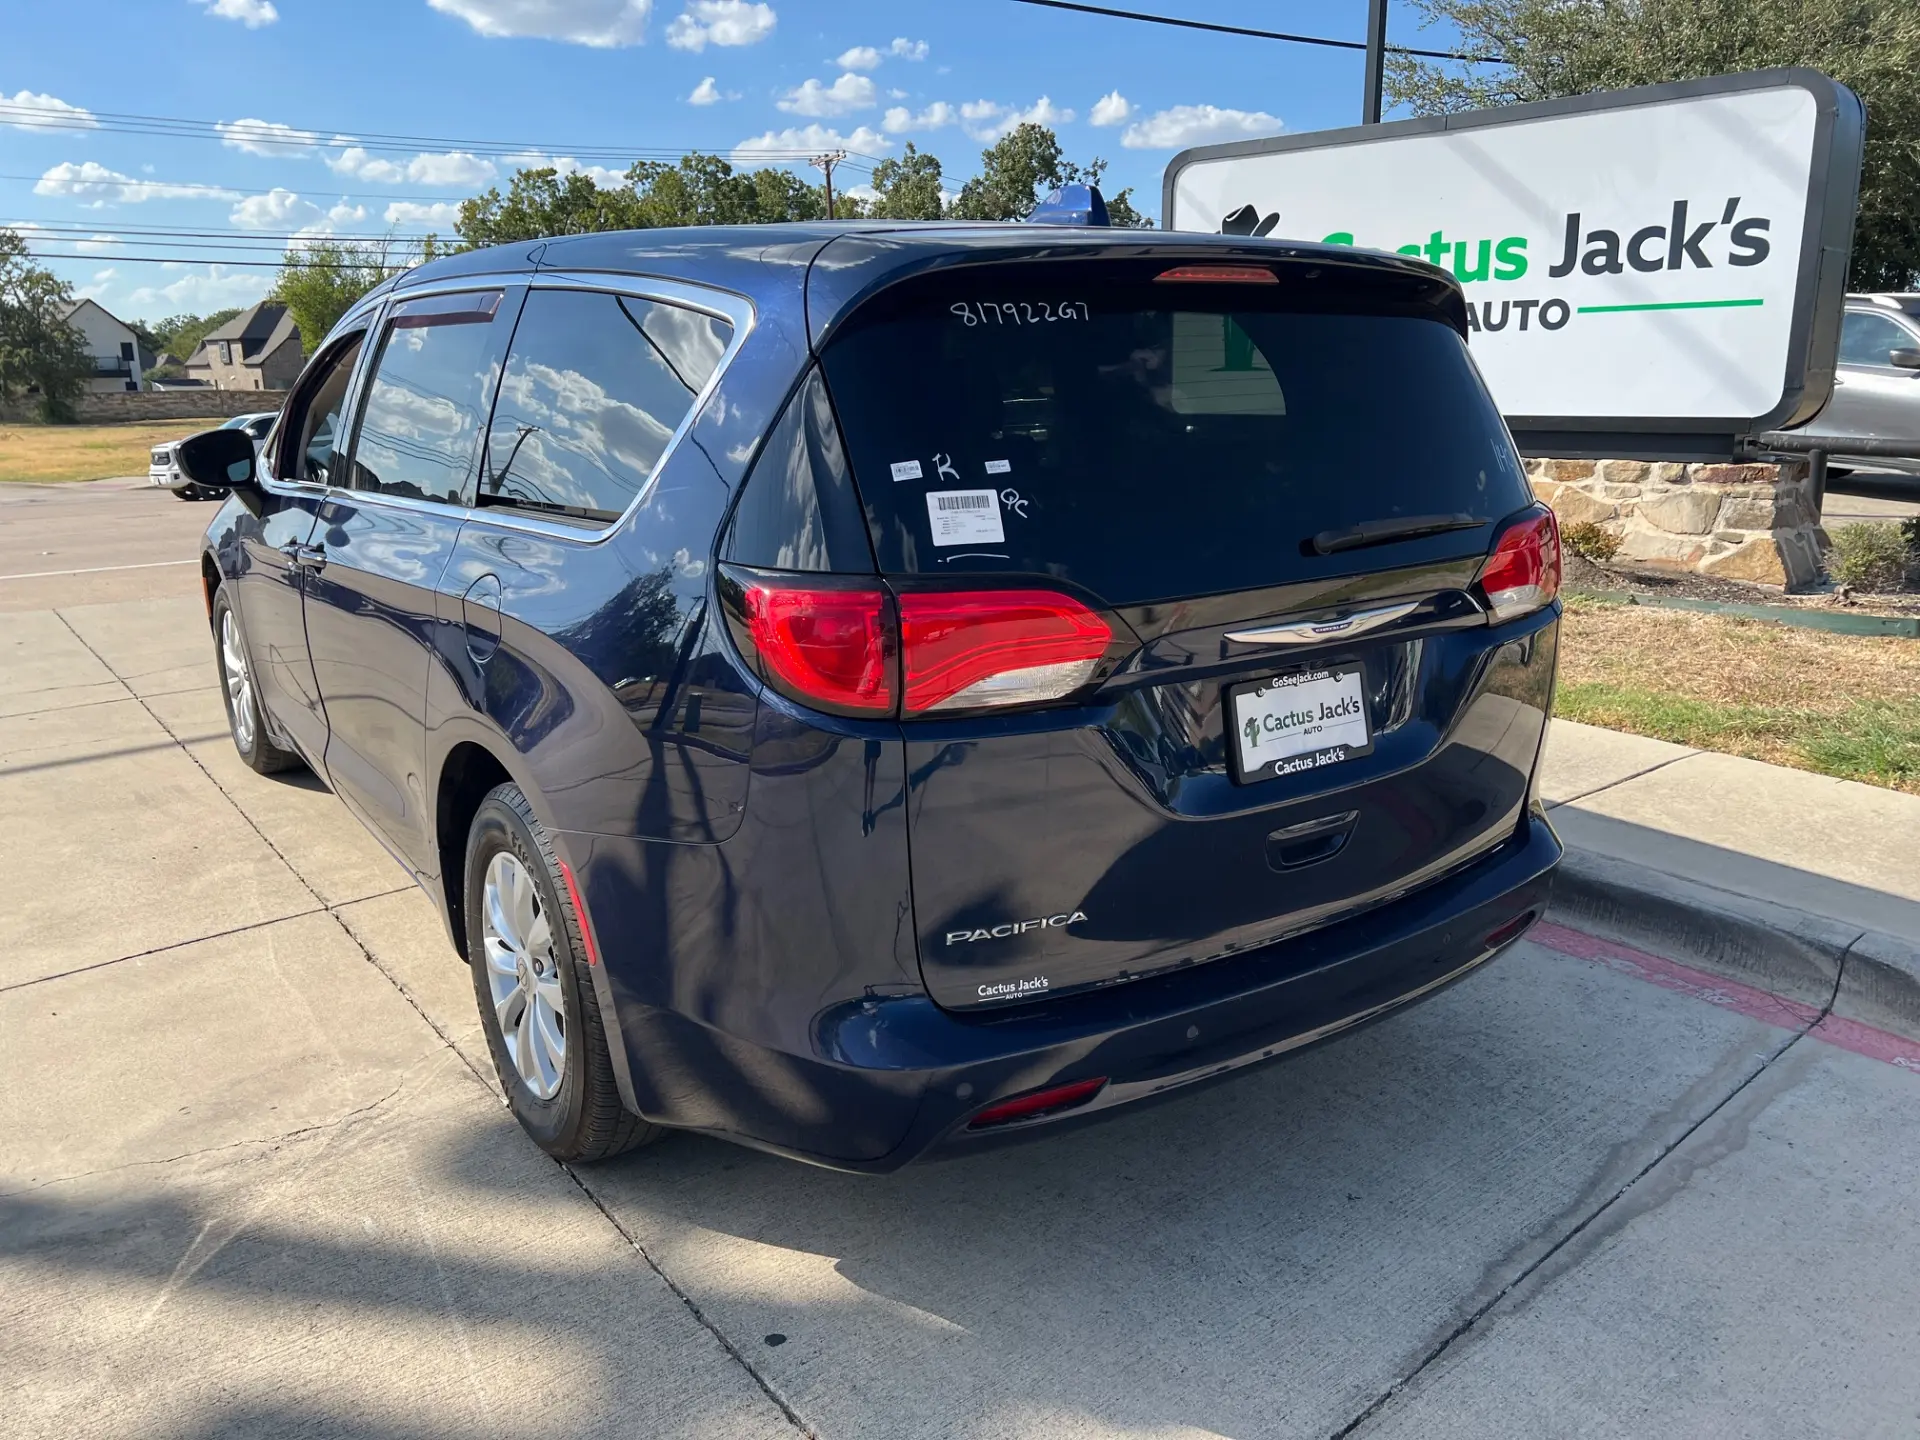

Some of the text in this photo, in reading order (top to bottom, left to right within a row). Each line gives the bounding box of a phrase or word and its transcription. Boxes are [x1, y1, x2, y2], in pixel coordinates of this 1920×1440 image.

[1320, 196, 1771, 284] tus Jack's
[1271, 669, 1329, 688] GoSeeJack.com
[1262, 695, 1361, 733] Cactus Jack's
[1303, 724, 1323, 736] AUTO
[1274, 747, 1345, 776] Cactus Jack's
[945, 910, 1089, 946] PACIFICA
[977, 975, 1049, 996] Cactus Jack's
[1005, 992, 1023, 1000] AUTO
